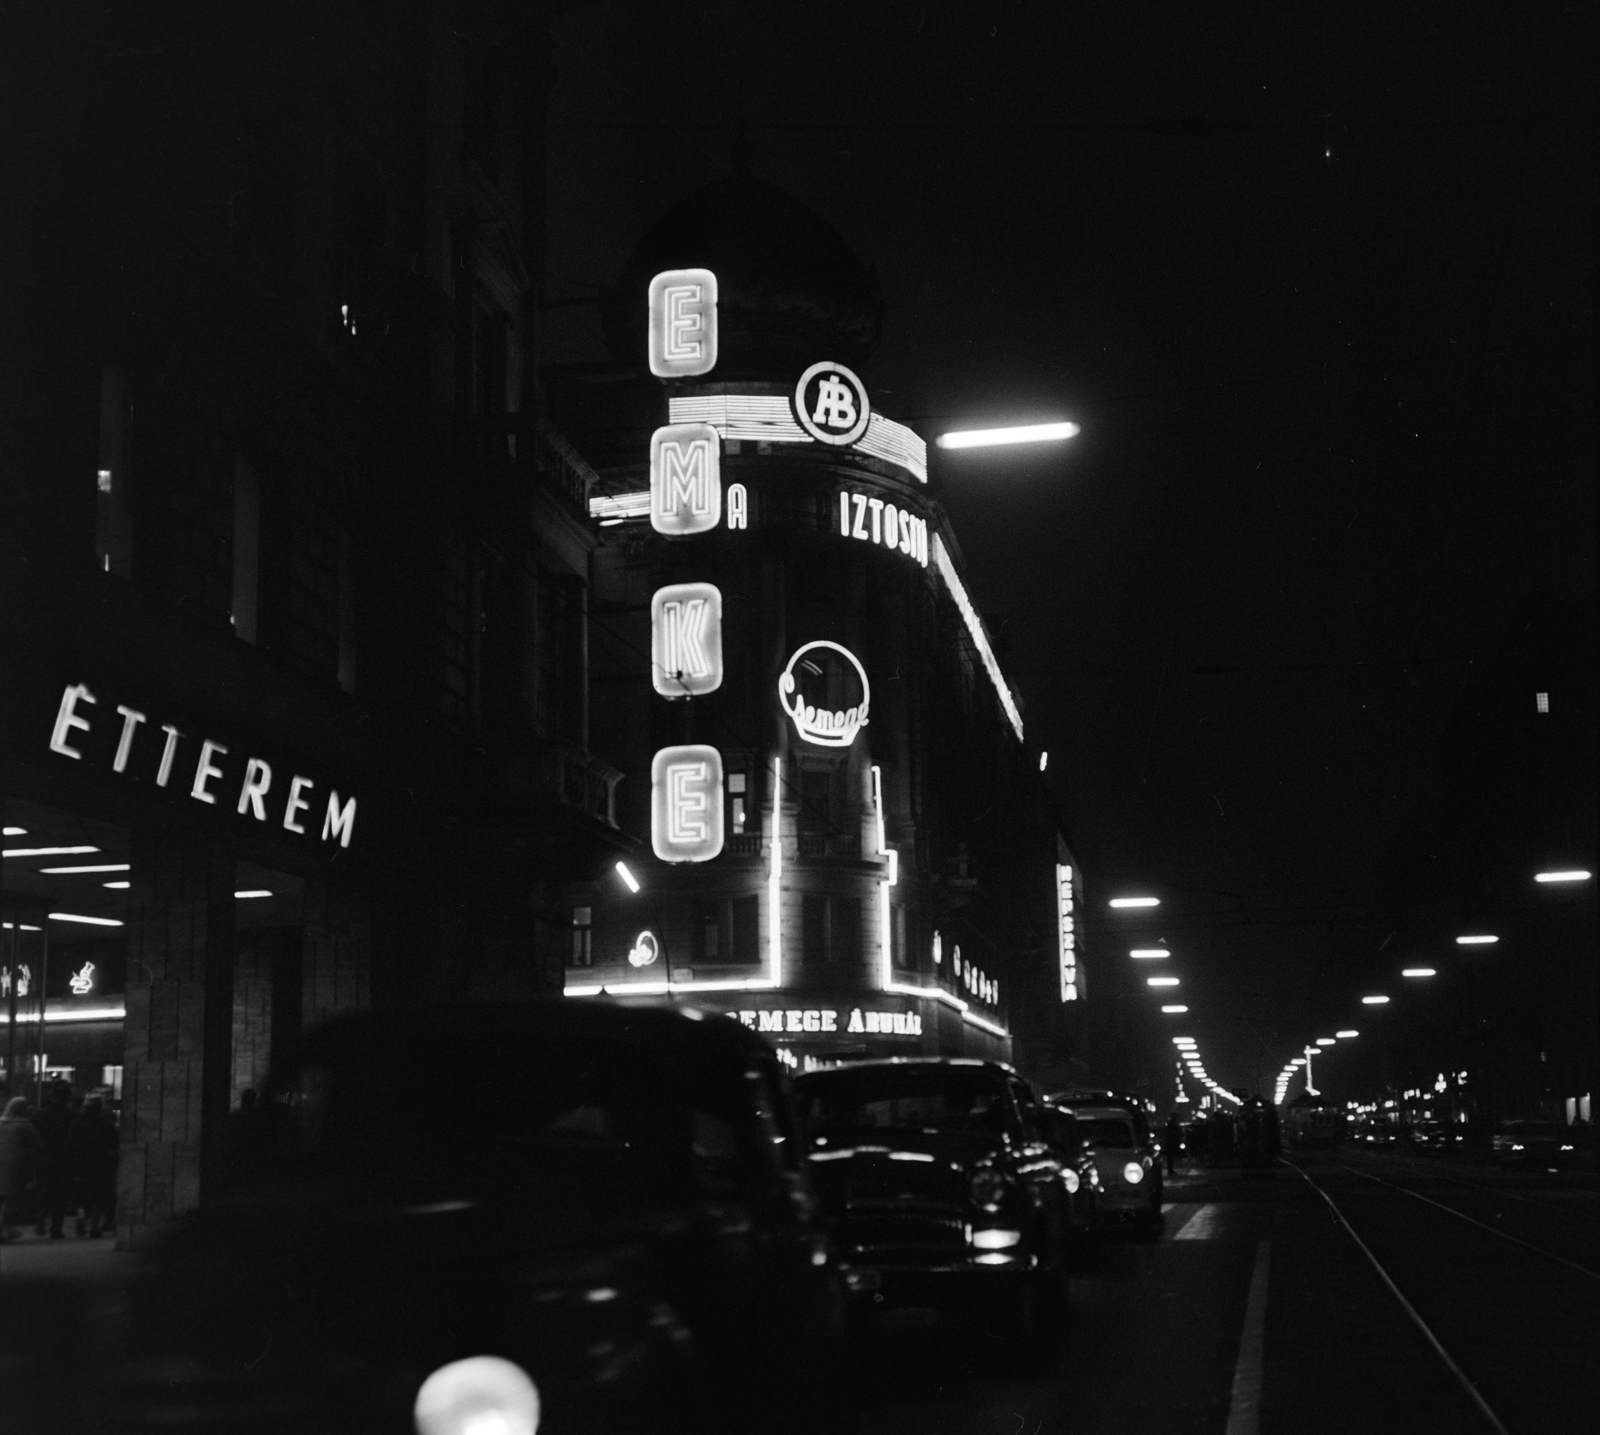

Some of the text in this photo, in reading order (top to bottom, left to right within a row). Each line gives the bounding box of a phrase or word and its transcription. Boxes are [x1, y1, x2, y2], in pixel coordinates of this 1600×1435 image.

[659, 281, 712, 845] EMKE
[49, 682, 358, 849] ÉTTEREM
[725, 1009, 837, 1032] EMEGE
